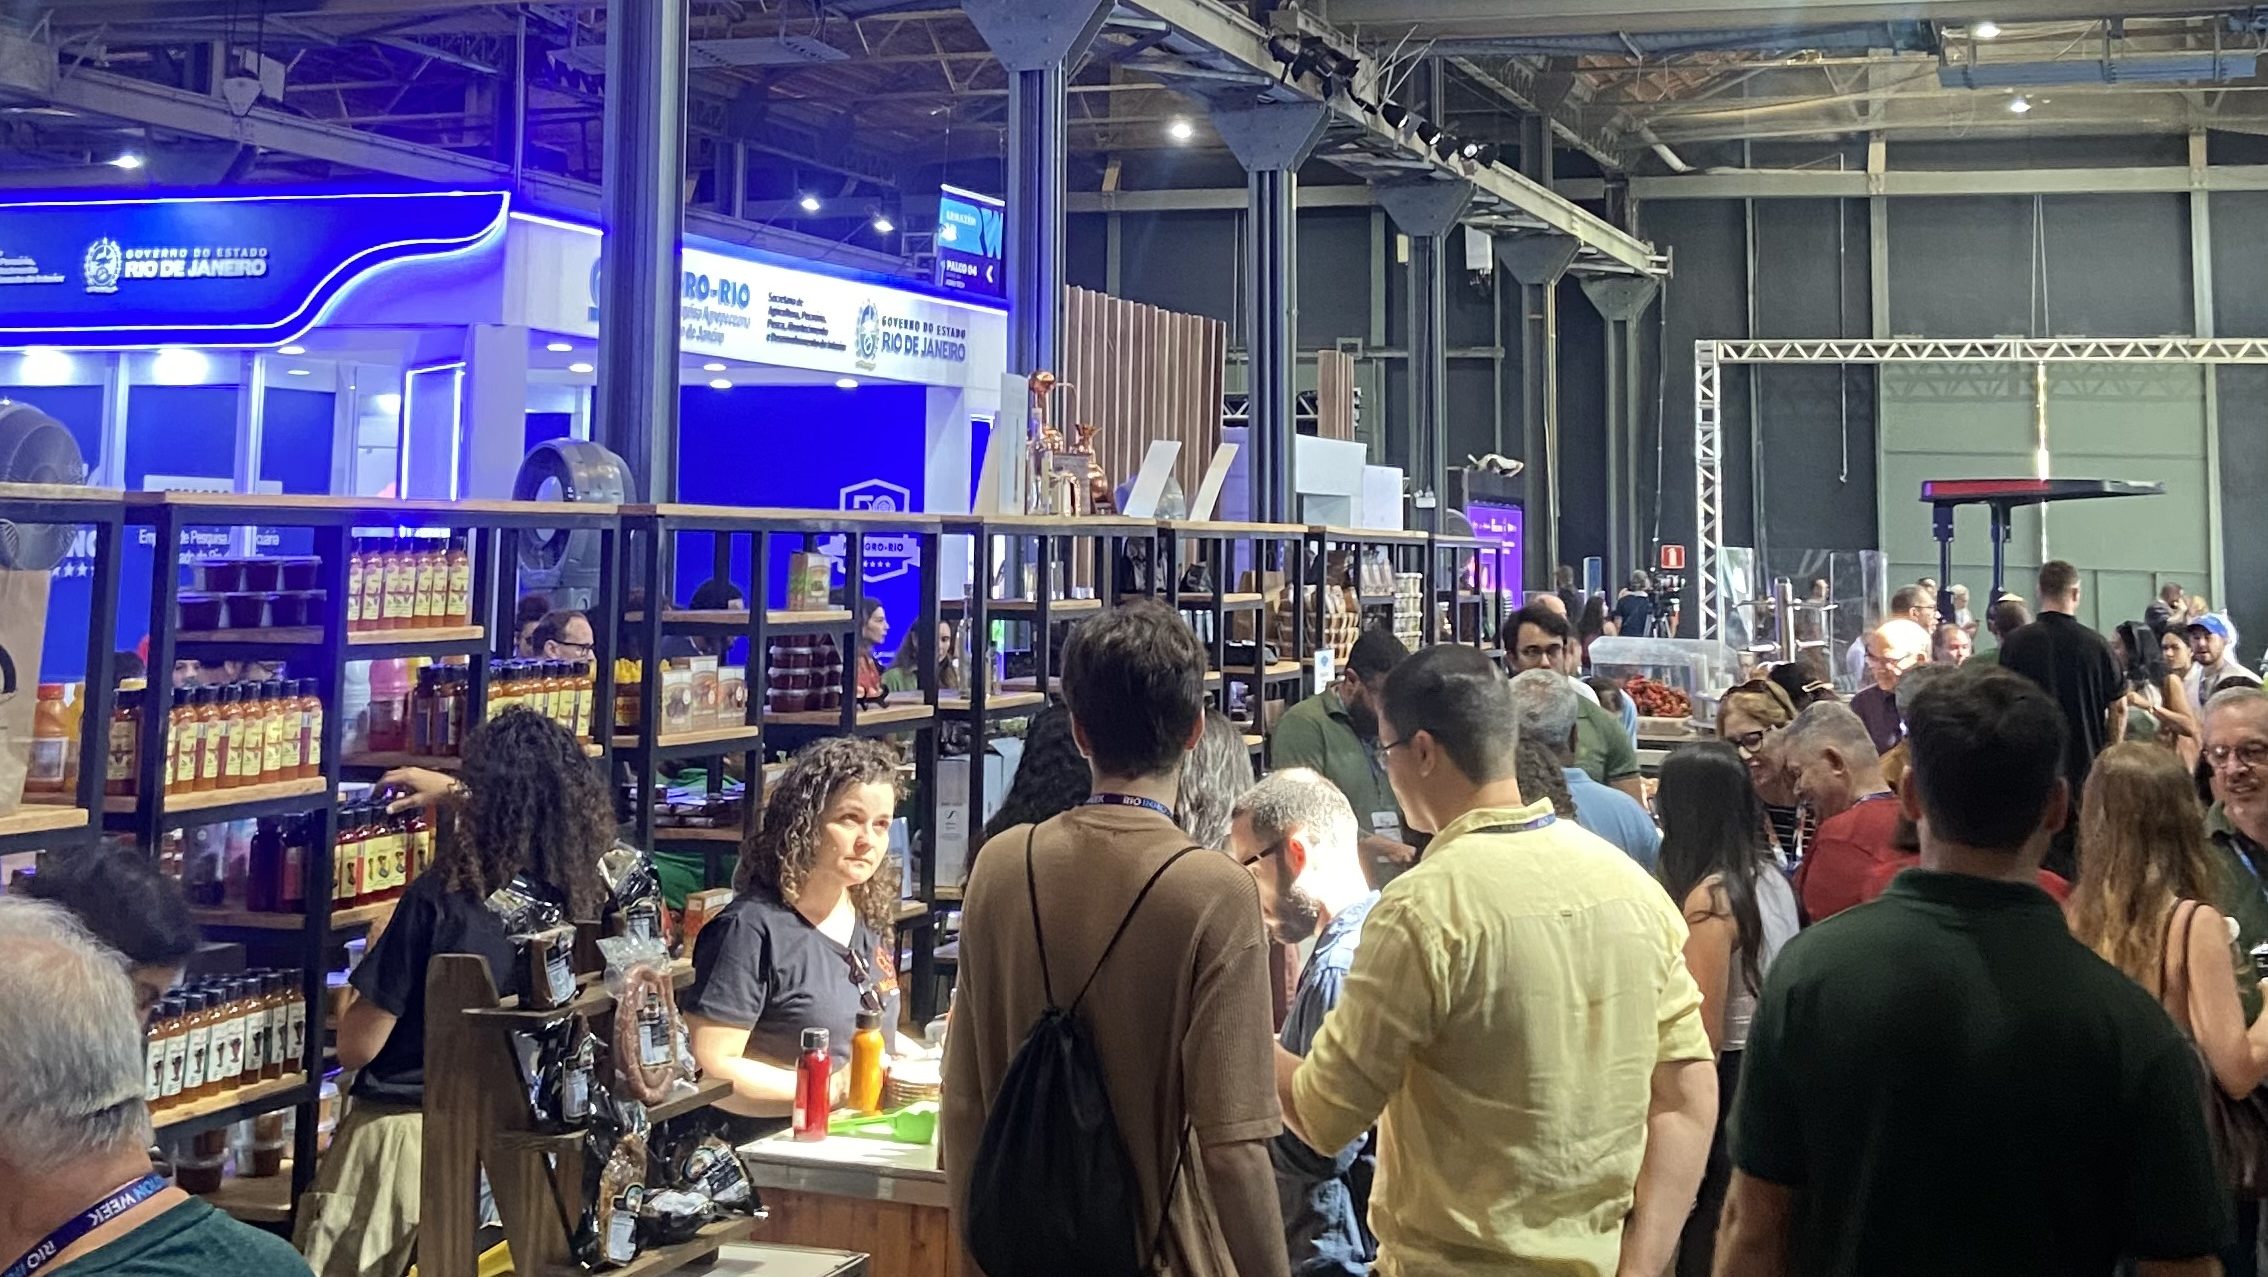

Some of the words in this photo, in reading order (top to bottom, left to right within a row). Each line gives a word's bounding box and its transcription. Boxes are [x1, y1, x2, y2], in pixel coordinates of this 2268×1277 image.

[126, 248, 187, 259] GOVERNO
[194, 247, 211, 258] DO
[217, 247, 268, 258] ESTADO
[125, 260, 158, 278] RIO
[160, 260, 185, 278] DE
[188, 259, 267, 277] JANEIRO
[946, 260, 967, 274] PALCO
[683, 271, 751, 310] RO-RIO
[881, 315, 920, 333] GOVERNO
[923, 321, 934, 333] DO
[936, 325, 966, 340] ESTADO
[881, 331, 903, 354] RIO
[904, 334, 919, 355] DE
[921, 337, 966, 363] JANEIRO
[864, 542, 904, 552] GRO-RIO
[1123, 795, 1142, 806] RIO
[88, 1193, 136, 1226] WEEK
[27, 1240, 57, 1269] RIO
